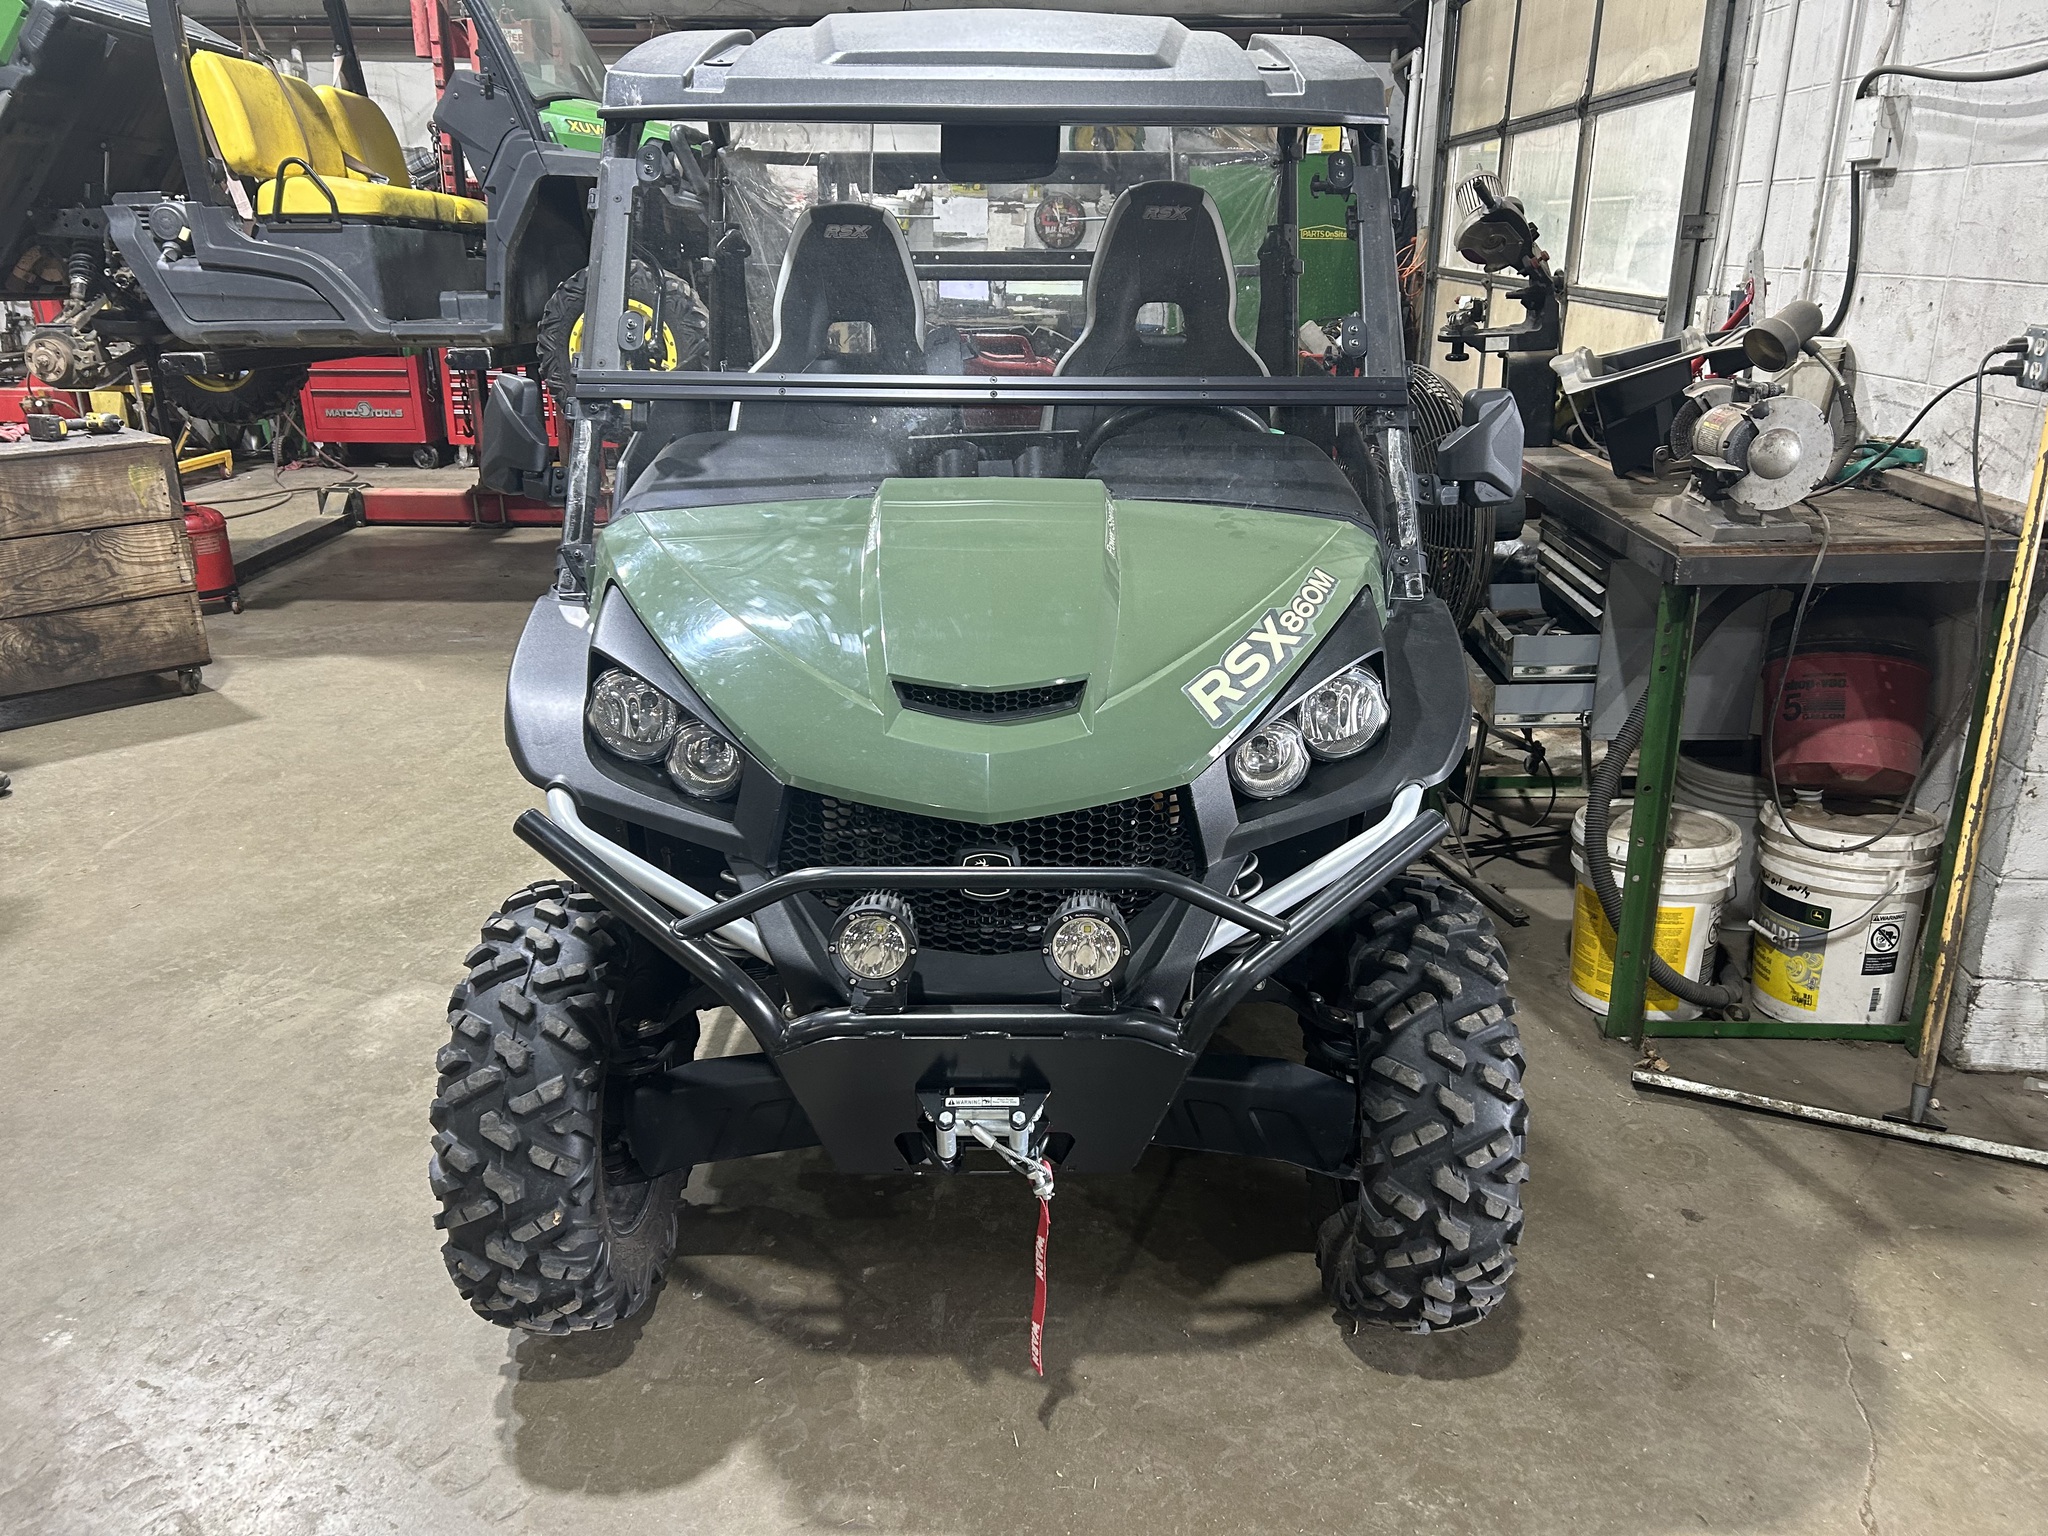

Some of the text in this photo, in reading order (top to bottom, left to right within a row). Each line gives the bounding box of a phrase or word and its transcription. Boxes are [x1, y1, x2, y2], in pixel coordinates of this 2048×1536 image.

[1142, 204, 1192, 220] RSX
[824, 223, 872, 239] RSX
[1302, 230, 1325, 238] PARTS
[325, 408, 403, 418] MATCO TOOLS
[1187, 568, 1336, 722] RSX 860M
[1783, 693, 1802, 721] 5
[1880, 913, 1905, 921] WARNING
[1035, 1234, 1046, 1282] WARN
[1031, 1320, 1041, 1367] WARN
